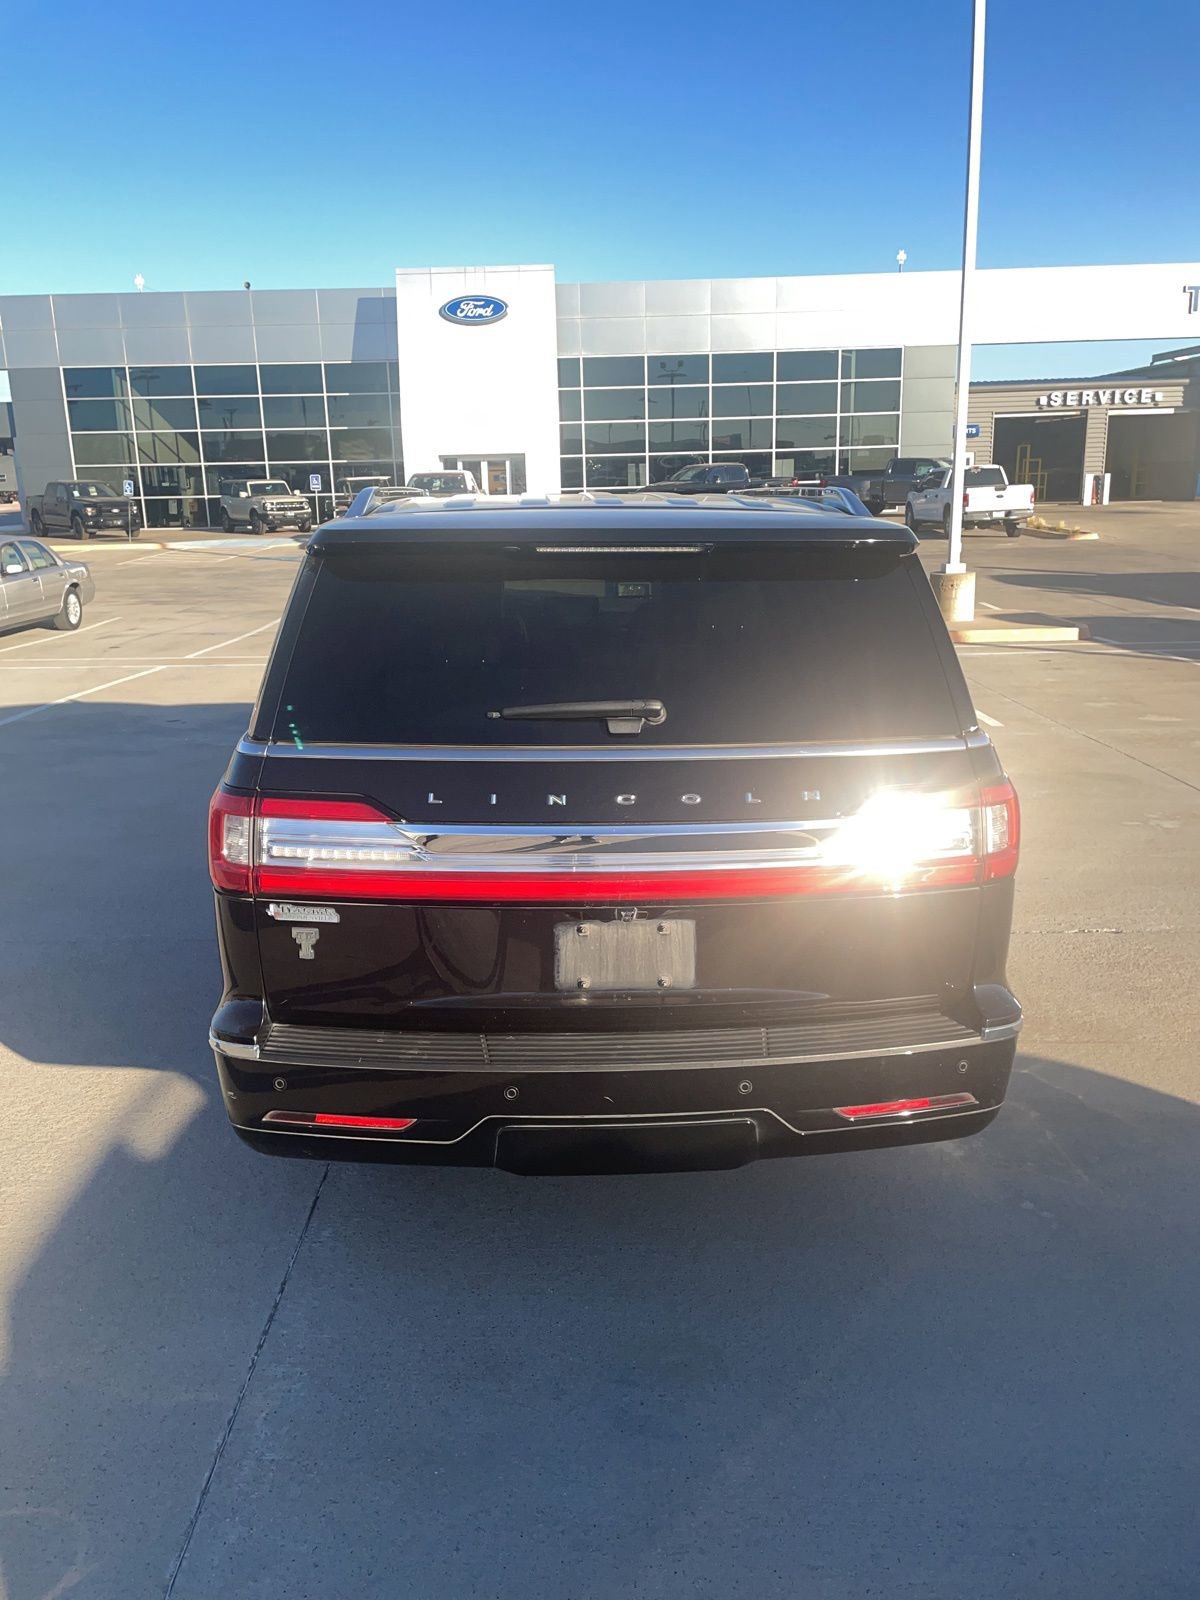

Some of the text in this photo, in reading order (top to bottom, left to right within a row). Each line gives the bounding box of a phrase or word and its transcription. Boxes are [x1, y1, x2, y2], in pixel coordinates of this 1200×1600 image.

[456, 300, 495, 318] Ford
[1049, 388, 1152, 407] SERVICE
[427, 790, 821, 806] LINCOLN
